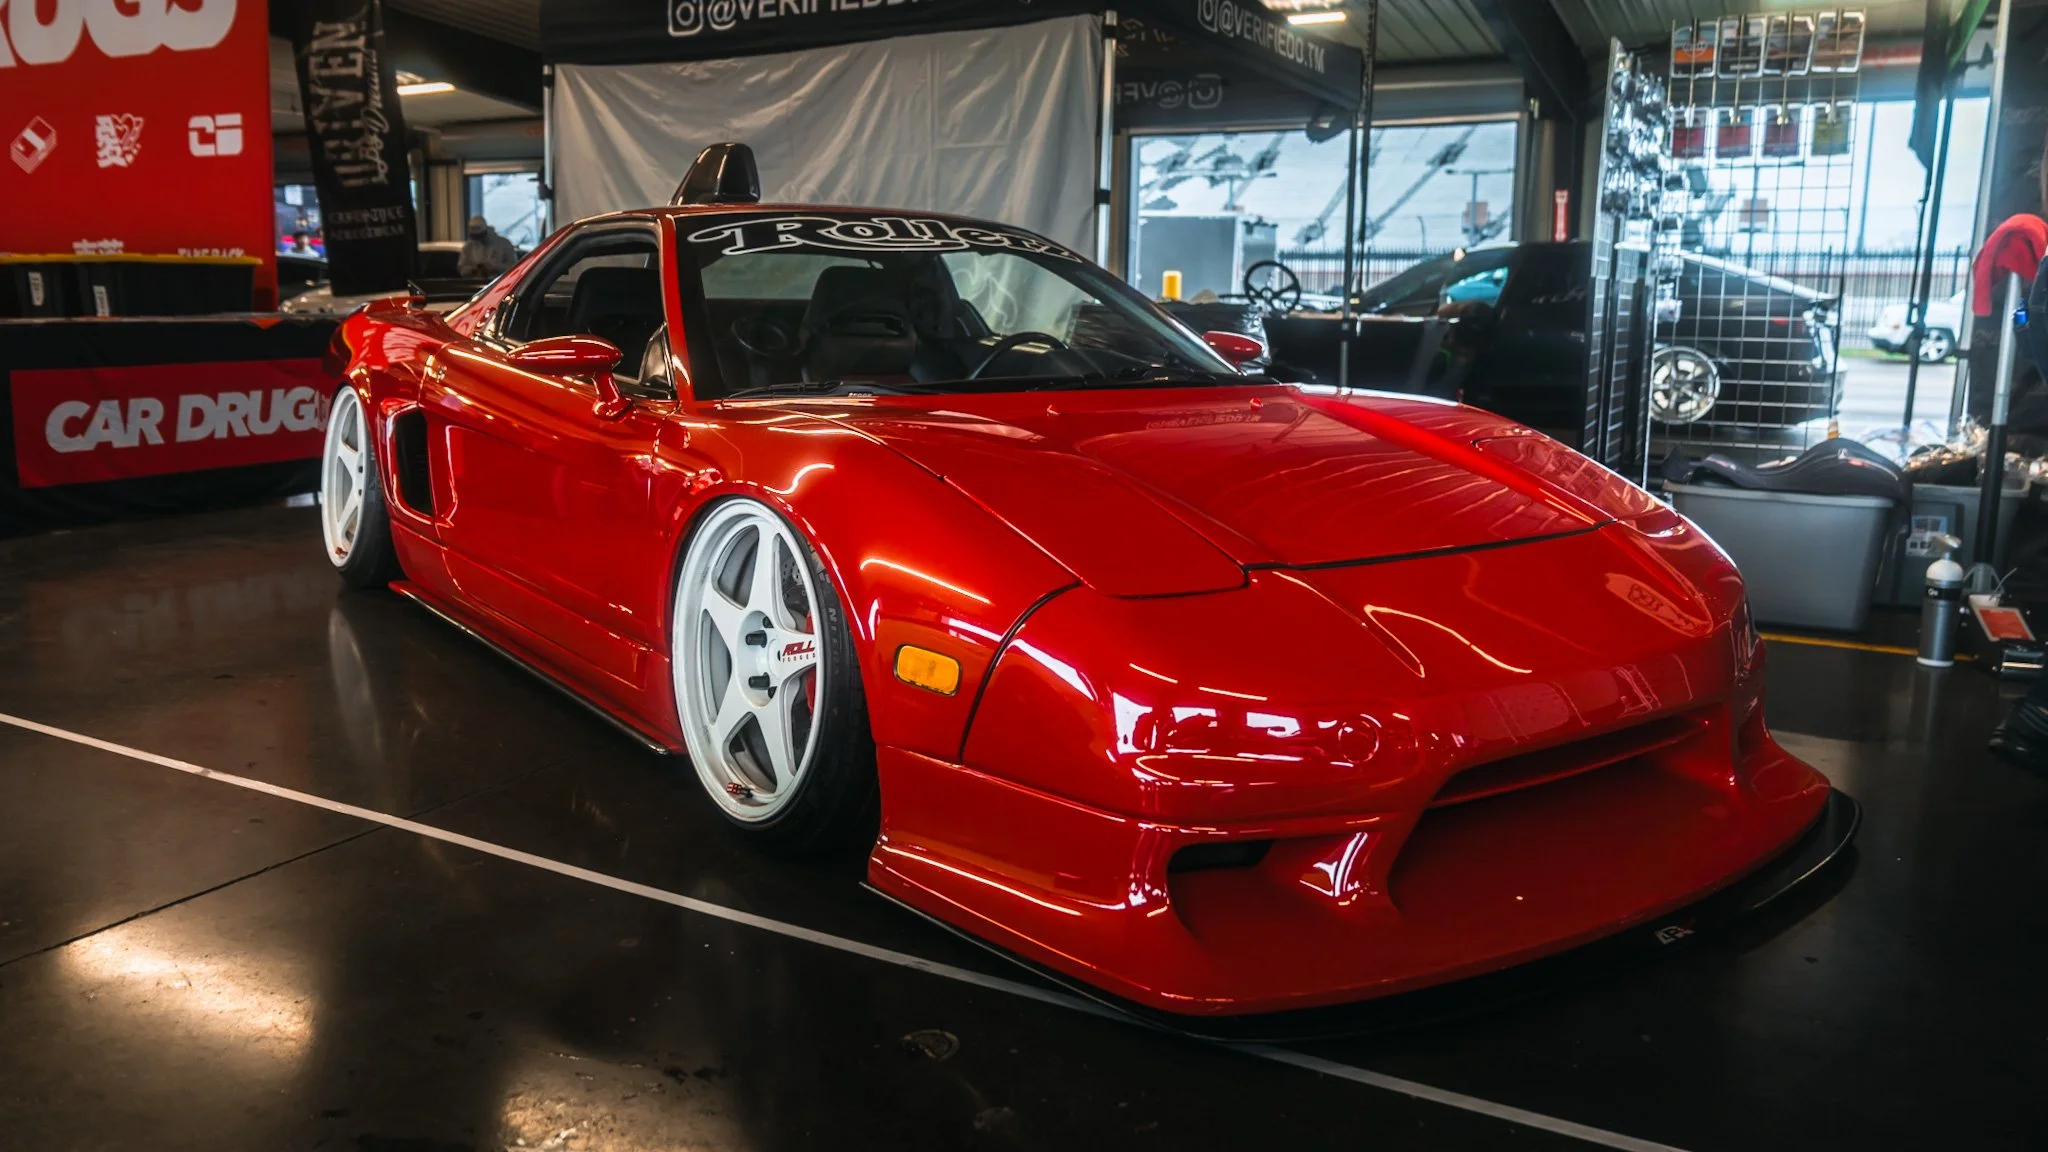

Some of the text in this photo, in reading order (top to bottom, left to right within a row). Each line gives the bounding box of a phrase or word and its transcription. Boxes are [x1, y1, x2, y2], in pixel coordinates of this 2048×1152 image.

[0, 0, 237, 67] UGS
[1219, 1, 1325, 74] @VERIFIEDD.TM
[45, 398, 164, 453] CAR
[782, 640, 816, 656] ROLL
